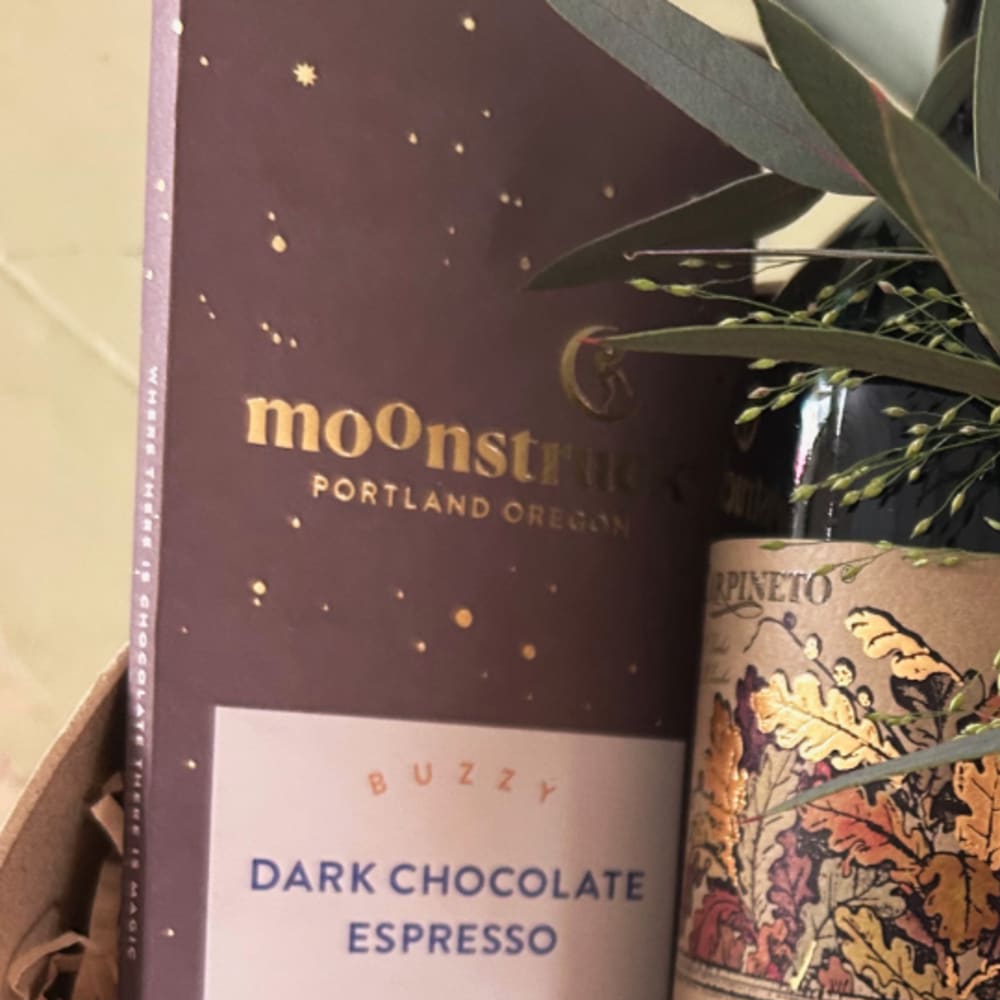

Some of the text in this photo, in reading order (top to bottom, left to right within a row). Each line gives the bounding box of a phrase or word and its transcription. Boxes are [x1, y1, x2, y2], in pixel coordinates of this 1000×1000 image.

[245, 396, 690, 503] moonstruc
[311, 475, 632, 538] PORTLAND OREGON
[711, 570, 833, 605] RPINETO
[127, 365, 159, 961] WHERE THERE IS CHOCOLATE THERE IS MAGIC
[368, 761, 557, 804] BUZZY
[250, 858, 646, 901] DARK CHOCOLATE
[347, 921, 559, 957] ESPRESSO
